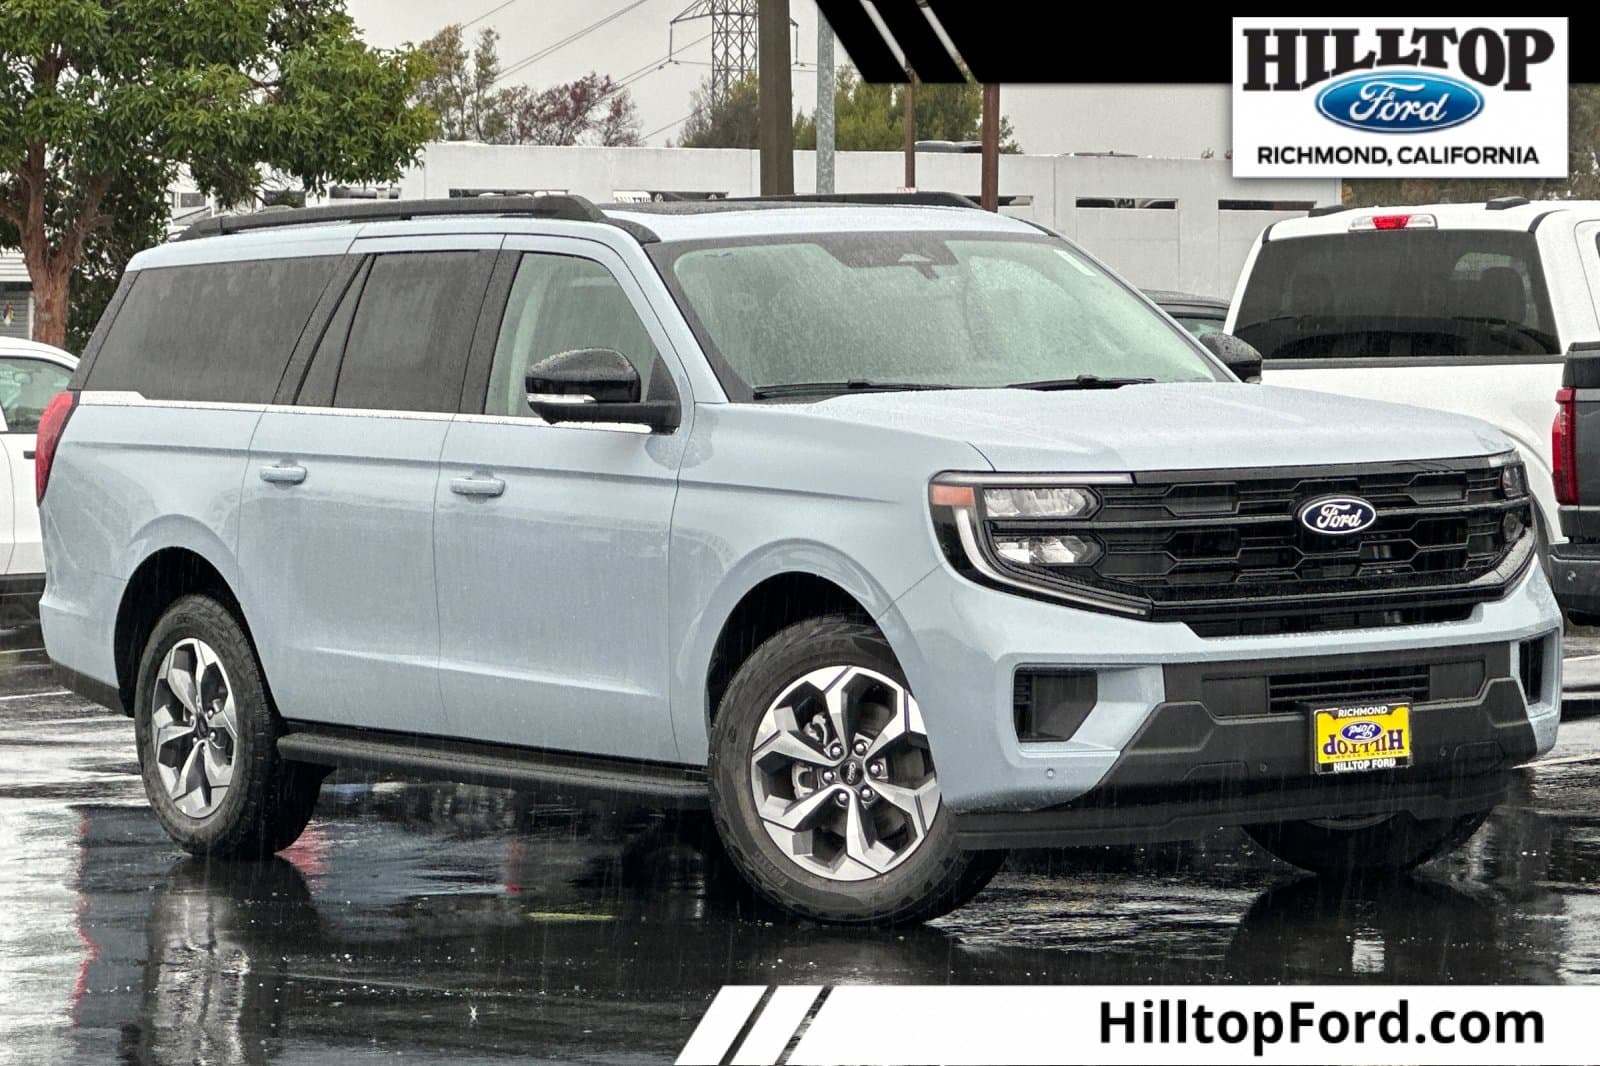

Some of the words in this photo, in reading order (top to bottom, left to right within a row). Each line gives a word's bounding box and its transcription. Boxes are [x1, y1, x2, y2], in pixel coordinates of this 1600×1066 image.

[1317, 503, 1363, 528] Ford
[1338, 706, 1388, 717] RICHMOND
[1347, 724, 1376, 739] Ford
[1323, 729, 1404, 755] HILLTOP
[1333, 760, 1370, 772] HILLTOP
[1371, 758, 1396, 769] FORD
